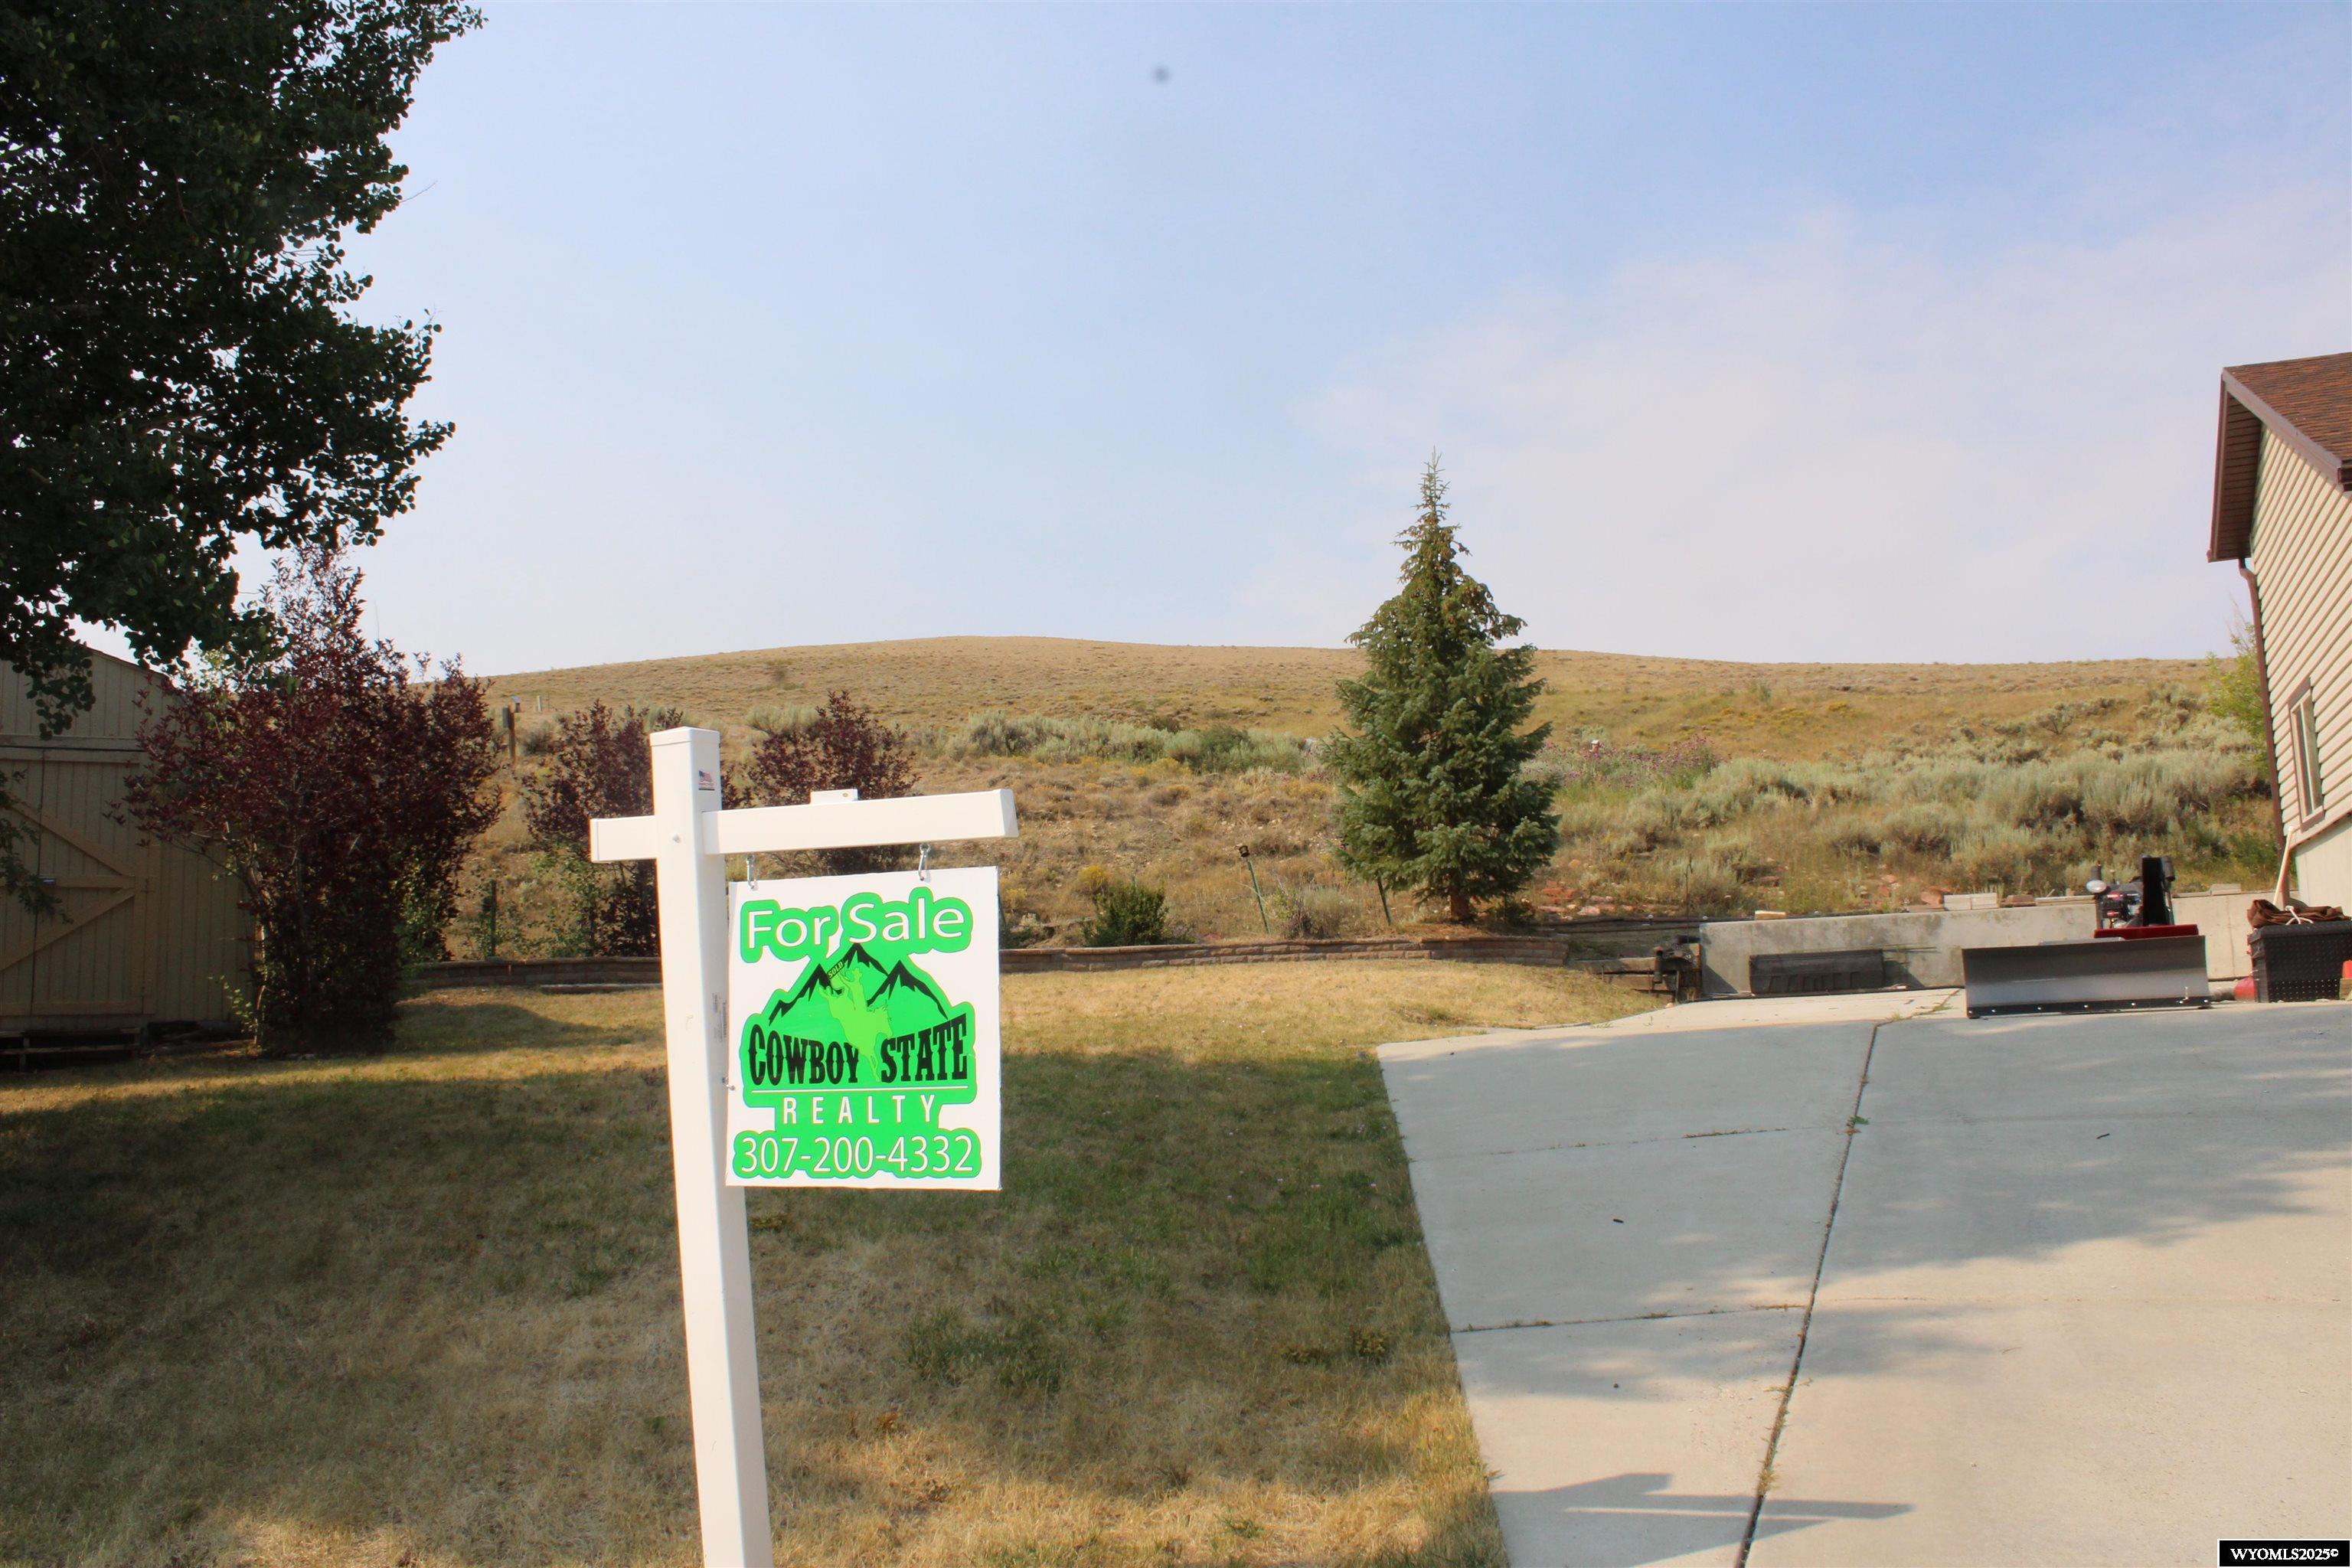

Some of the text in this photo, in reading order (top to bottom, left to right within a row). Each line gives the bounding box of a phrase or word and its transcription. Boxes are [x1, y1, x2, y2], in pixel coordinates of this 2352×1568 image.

[749, 898, 964, 948] For Sale
[828, 962, 843, 978] SOLD
[749, 1014, 967, 1086] COWBOY STATE
[782, 1095, 935, 1124] REALTY
[741, 1135, 973, 1173] 307-200-4332
